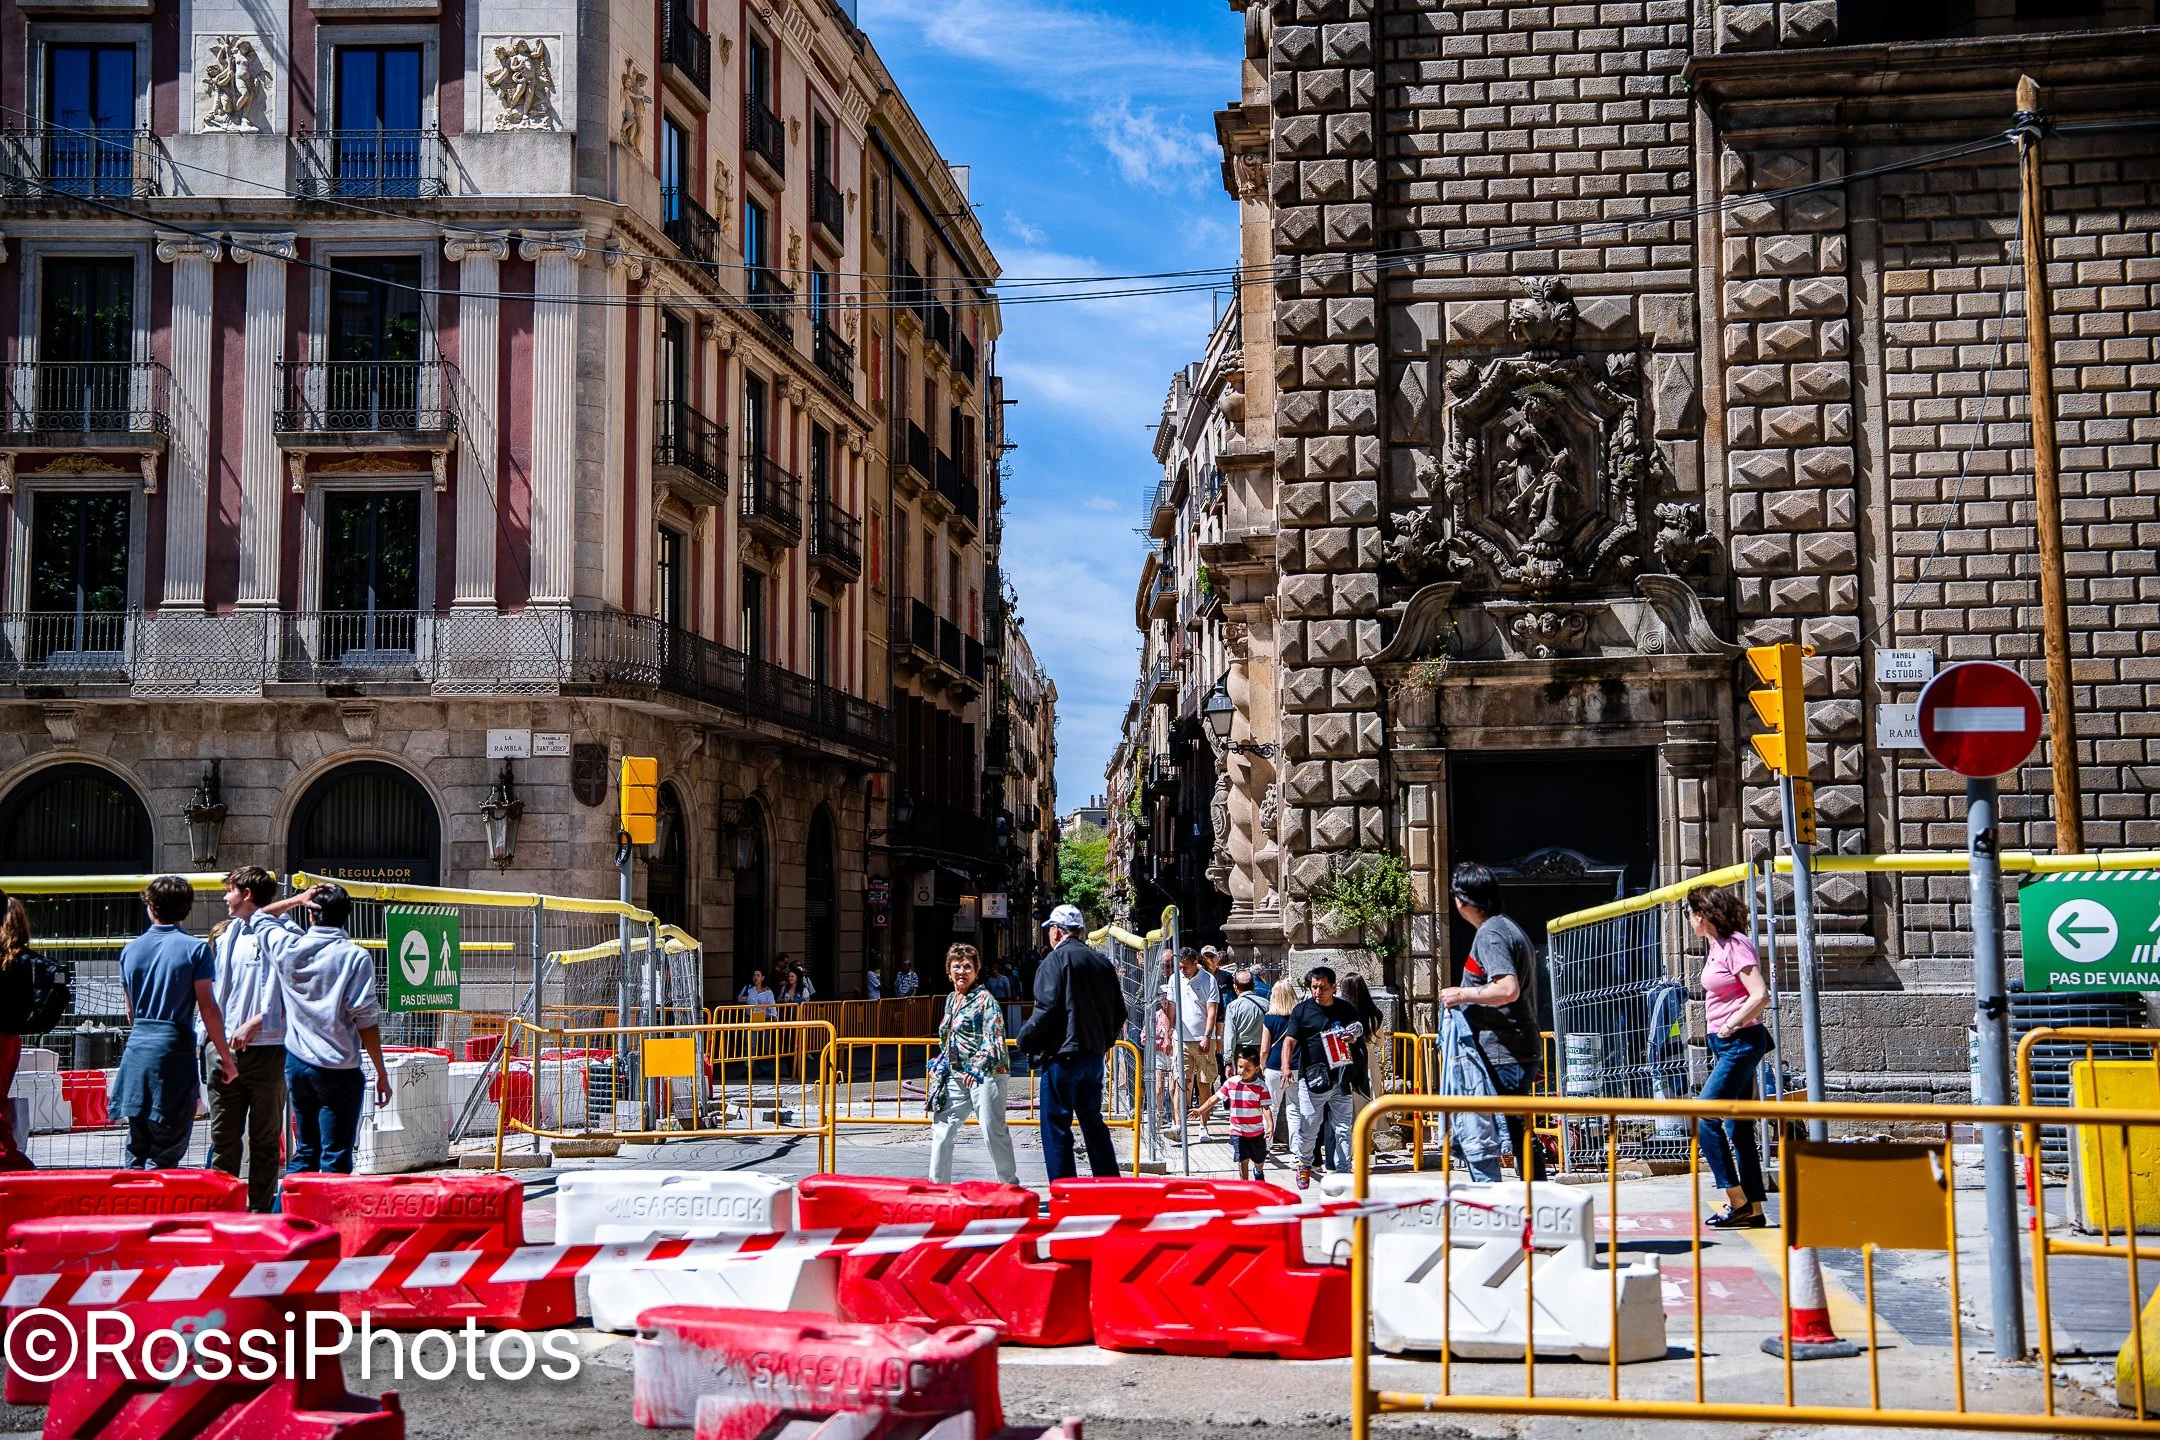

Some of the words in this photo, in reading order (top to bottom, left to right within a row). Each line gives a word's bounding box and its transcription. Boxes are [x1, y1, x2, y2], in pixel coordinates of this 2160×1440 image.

[1886, 670, 1922, 678] ESTUDIS
[320, 868, 332, 877] EL
[338, 868, 411, 878] REGULADOR
[2050, 972, 2080, 984] PAS
[2084, 972, 2107, 984] DE
[400, 994, 416, 1006] PAS
[416, 994, 426, 1004] DE
[426, 994, 454, 1004] VIANANTS
